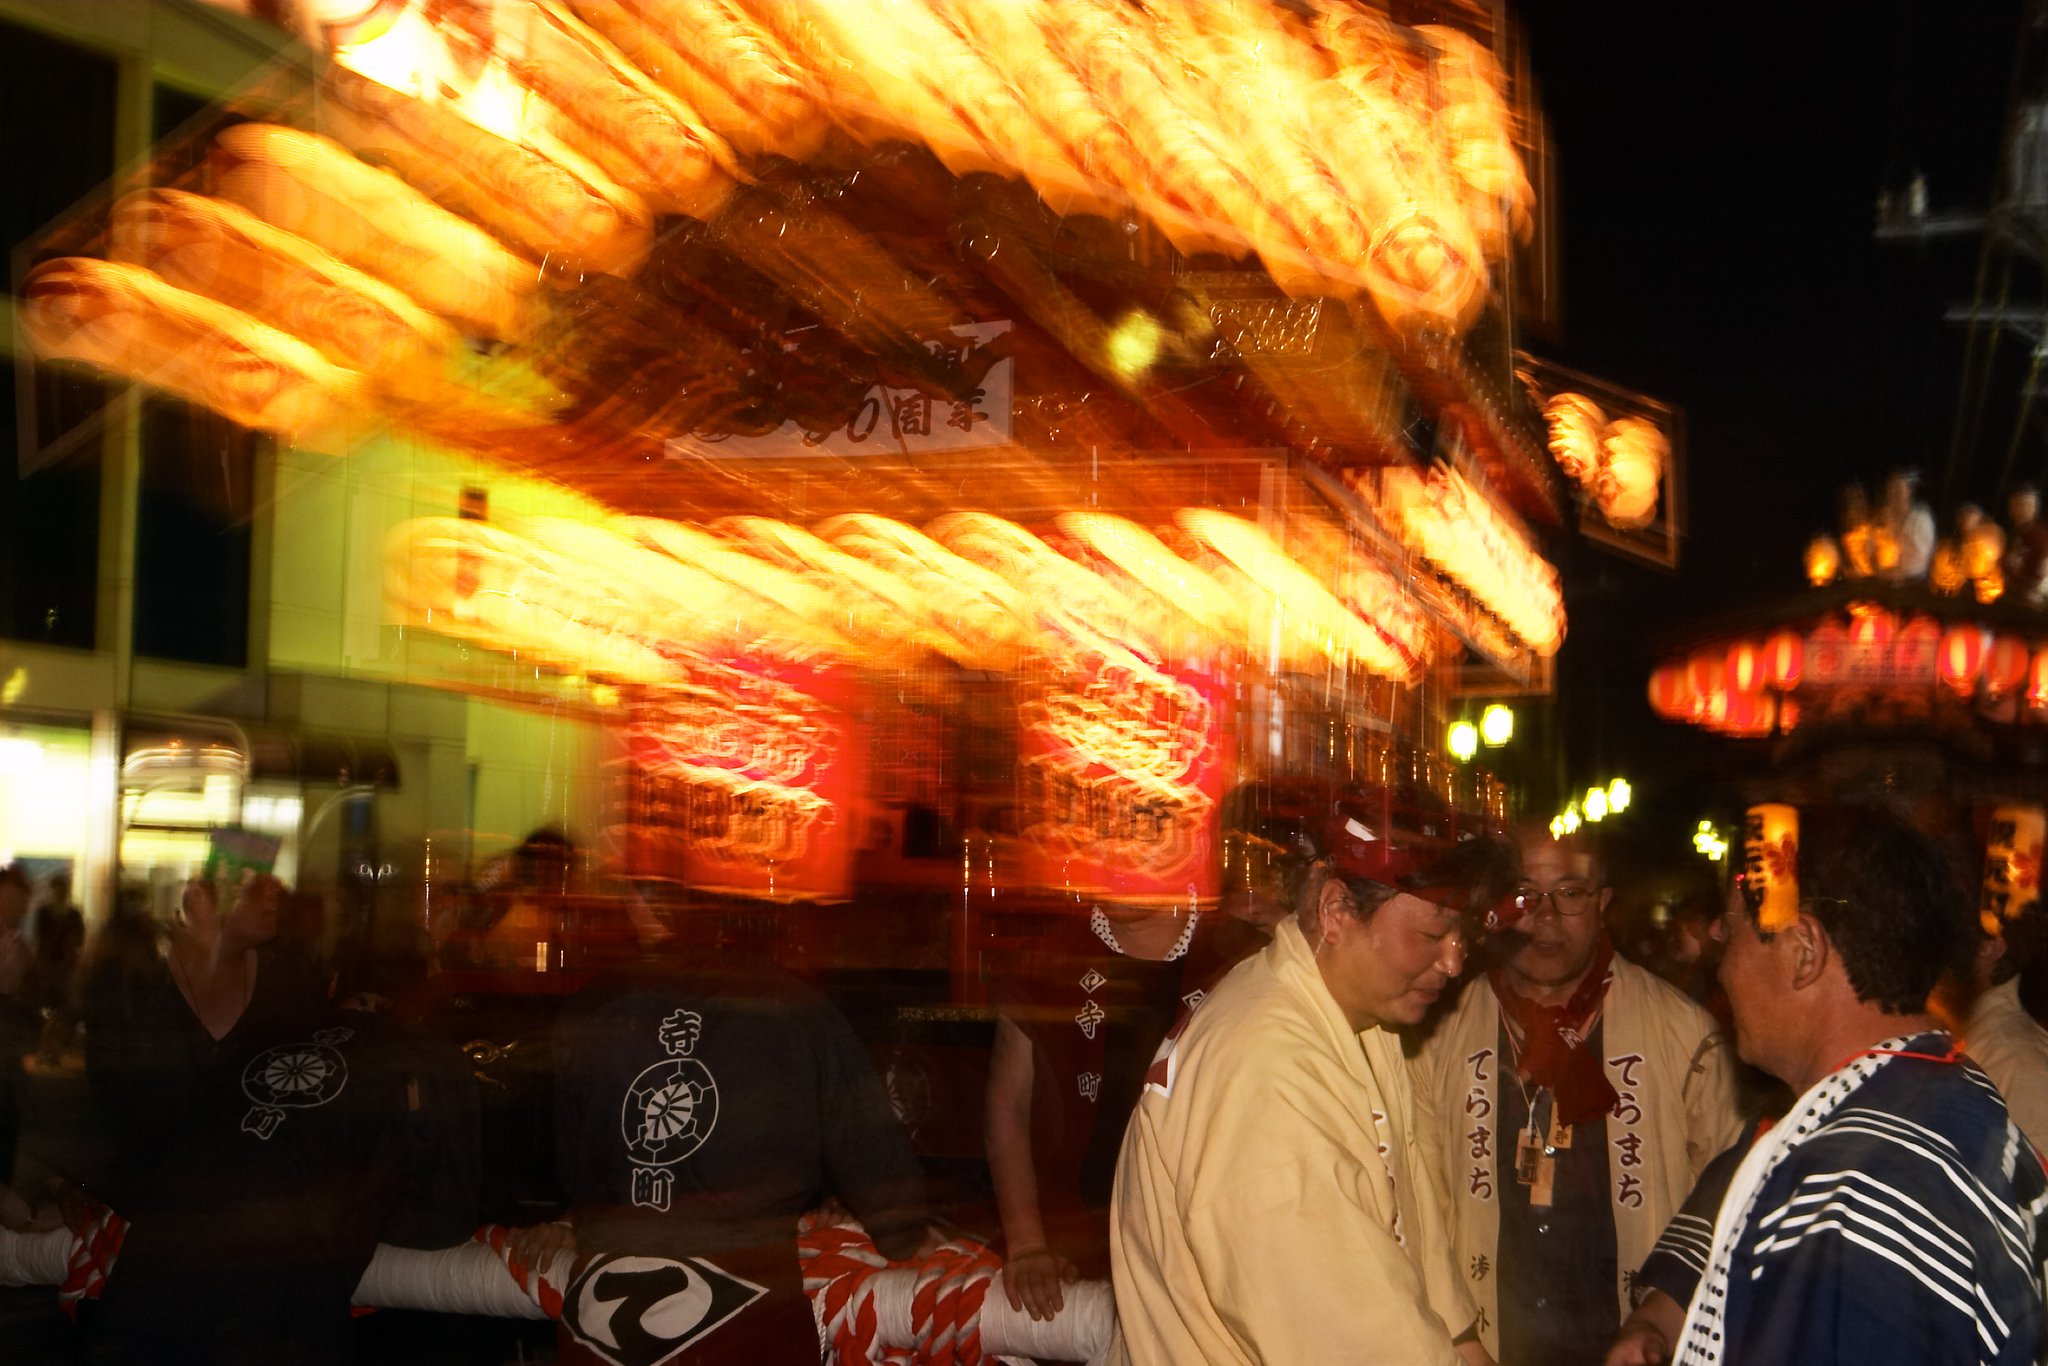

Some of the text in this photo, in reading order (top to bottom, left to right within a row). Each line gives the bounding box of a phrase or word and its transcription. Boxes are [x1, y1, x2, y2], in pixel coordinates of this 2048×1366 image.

[802, 388, 989, 447] 0周年
[1464, 1048, 1495, 1201] てらまち
[1607, 1052, 1646, 1209] てらまち
[631, 1167, 675, 1212] 町
